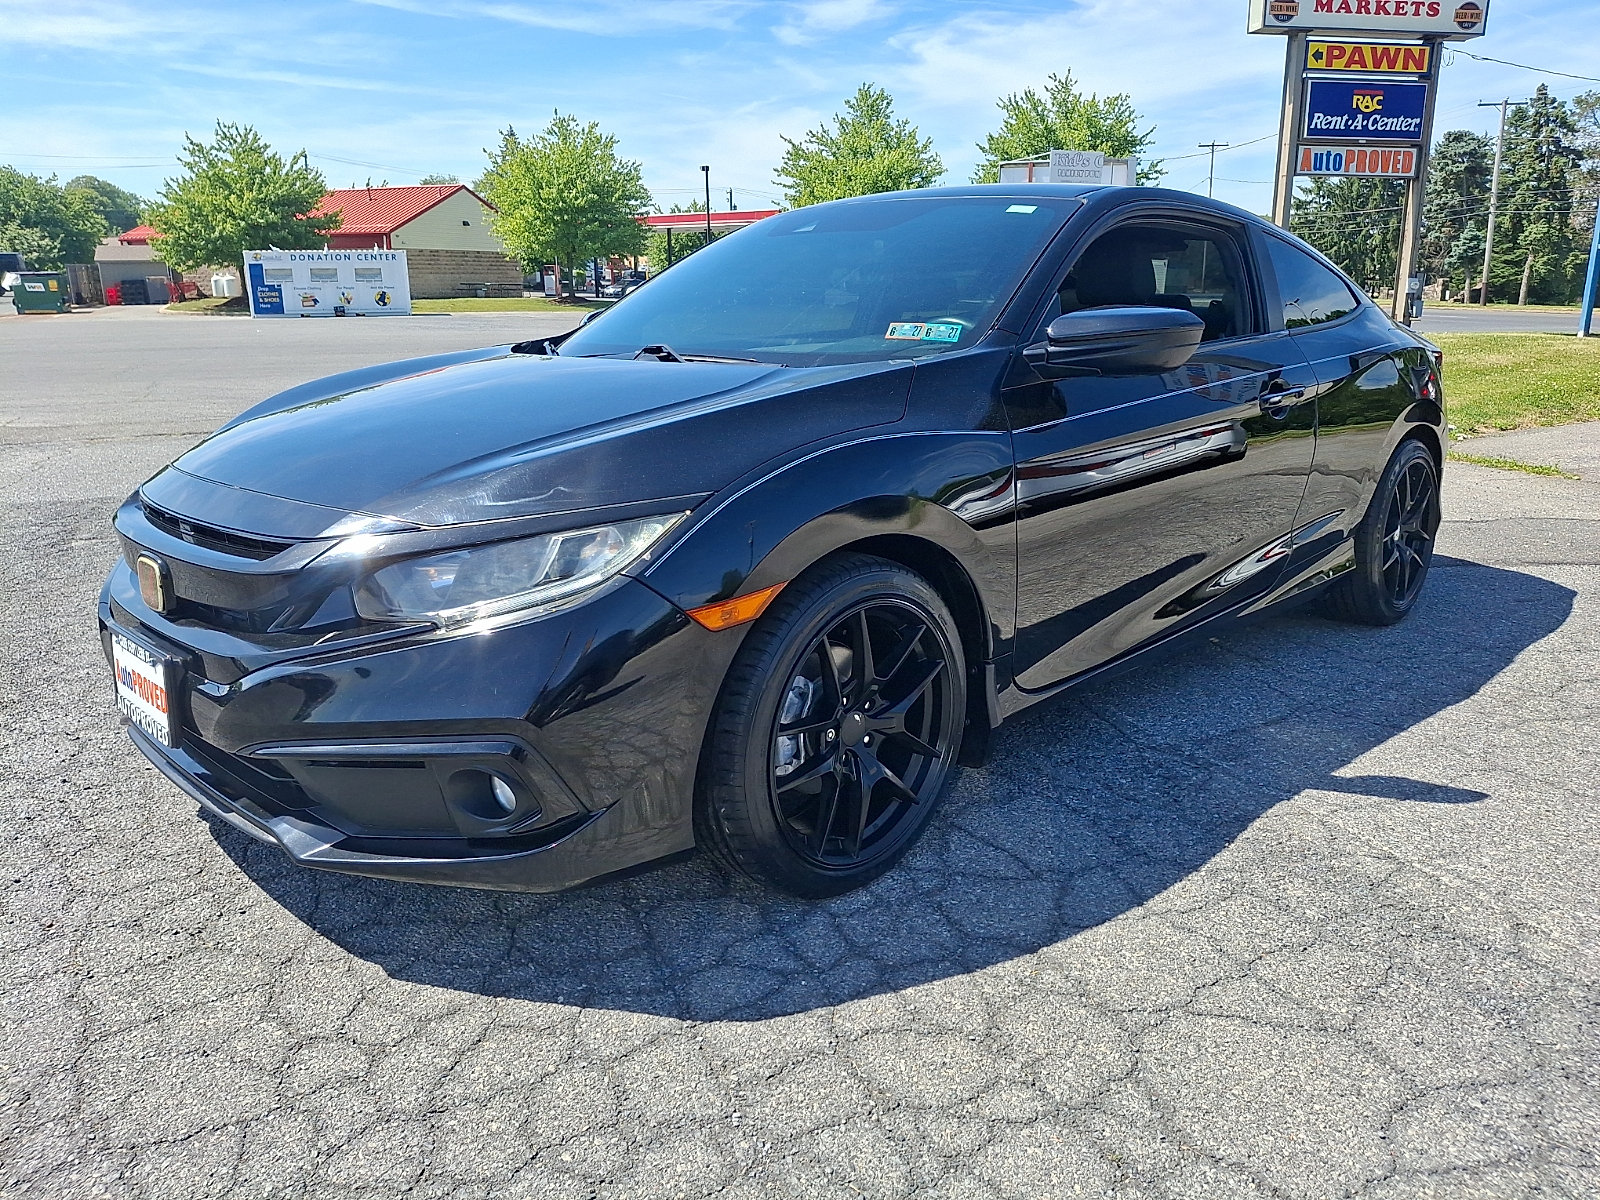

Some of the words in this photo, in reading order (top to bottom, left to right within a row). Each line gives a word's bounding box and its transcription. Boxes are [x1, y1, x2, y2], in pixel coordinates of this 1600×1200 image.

[1313, 0, 1440, 17] MARKETS
[1325, 45, 1426, 70] PAWN
[1352, 95, 1384, 113] RAC
[1054, 152, 1090, 167] Kid's
[1299, 147, 1414, 173] AutoPROVED
[290, 253, 351, 262] DONATION
[356, 253, 397, 261] CENTER
[889, 326, 896, 336] 6
[911, 325, 922, 336] 27
[947, 327, 958, 339] 27
[115, 658, 169, 714] AutoPROVED
[116, 692, 169, 747] AUTOPROVED
